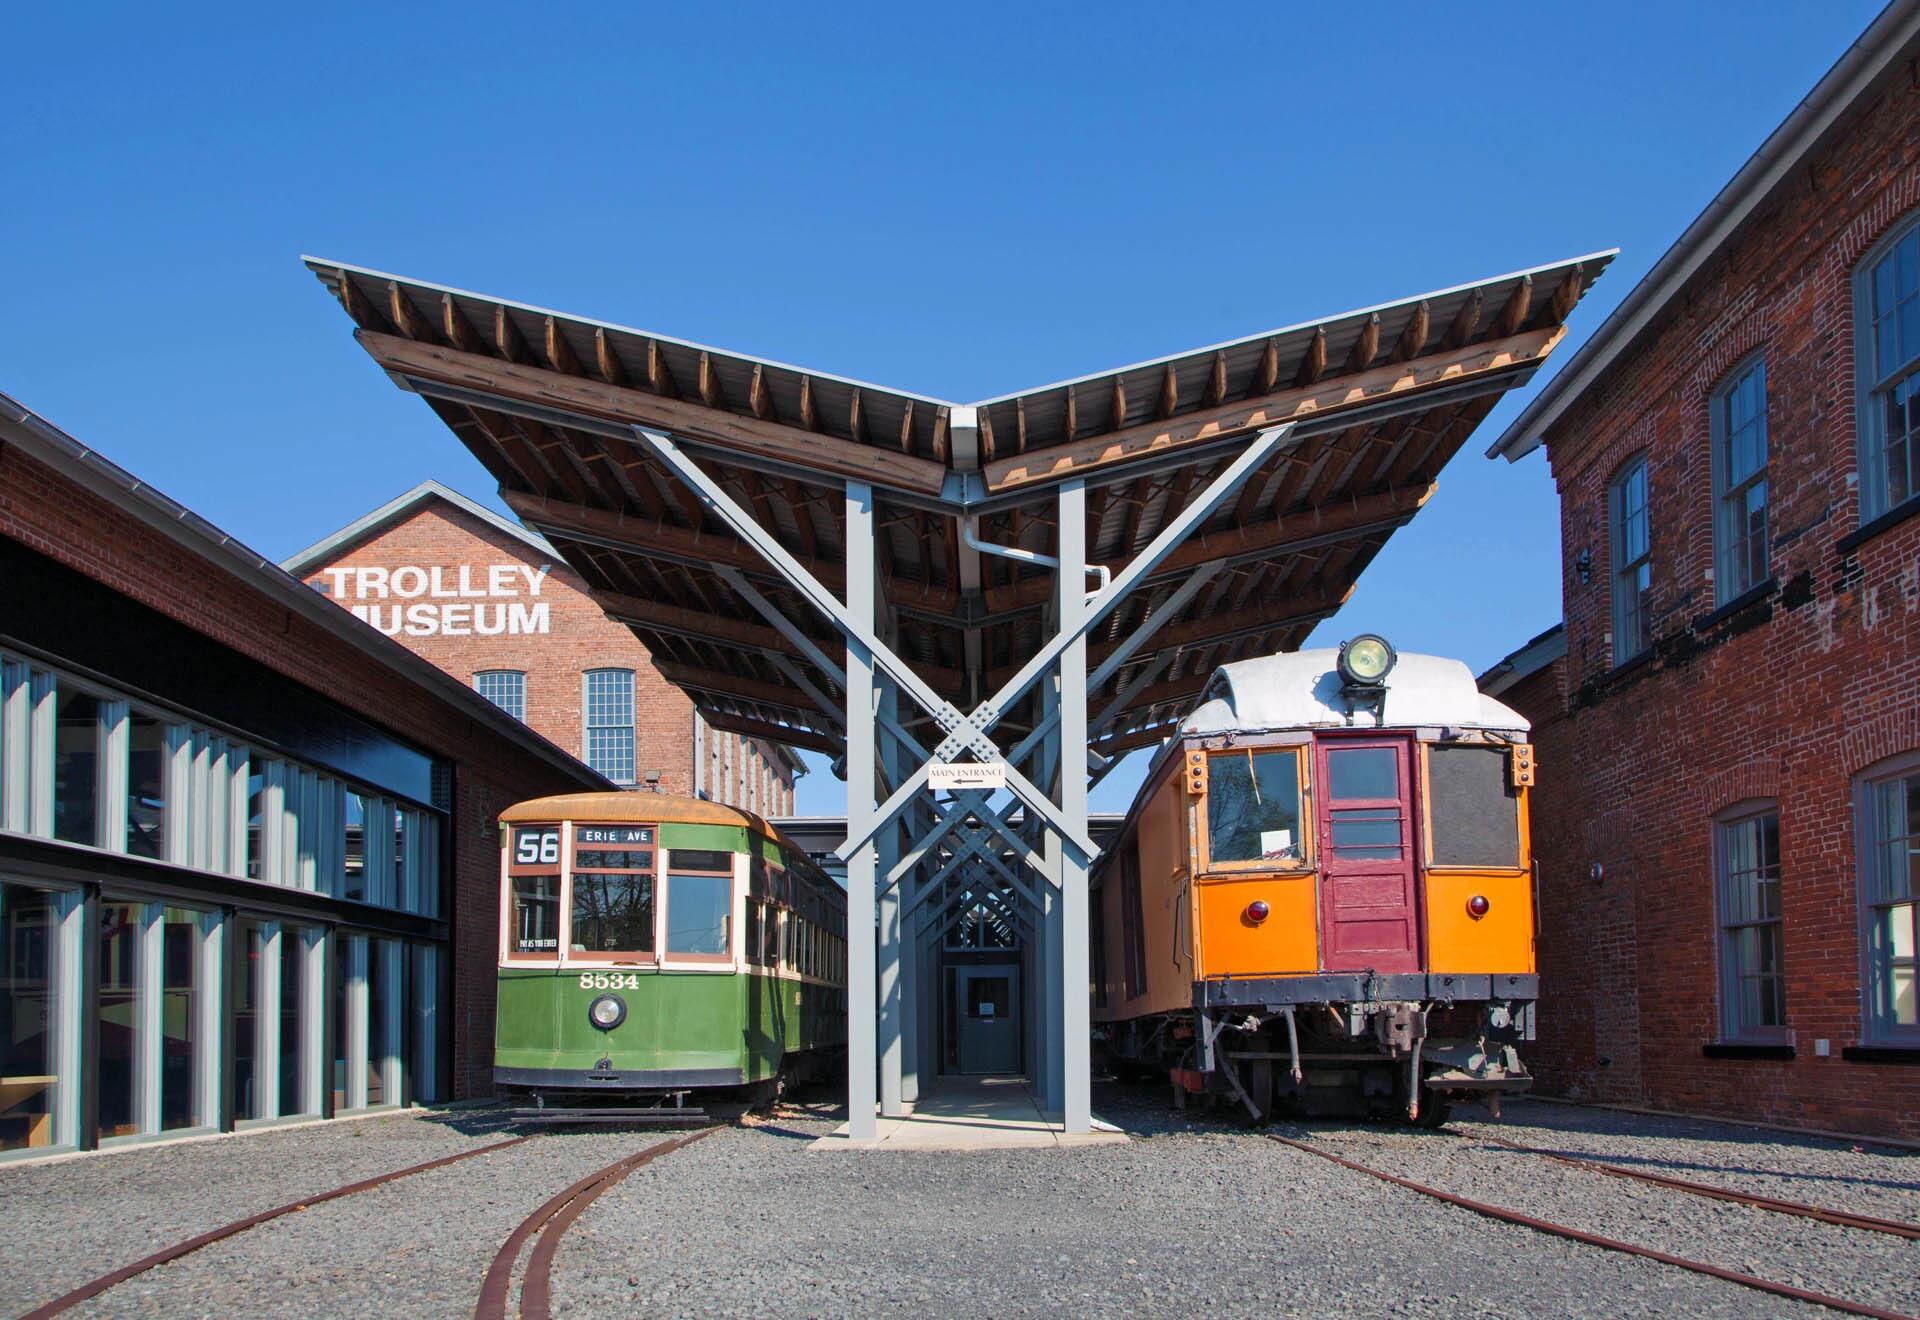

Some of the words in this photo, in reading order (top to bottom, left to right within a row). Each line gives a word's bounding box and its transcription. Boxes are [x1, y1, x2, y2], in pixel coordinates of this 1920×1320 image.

[323, 564, 551, 599] TROLLEY
[930, 768, 955, 777] MAIN
[957, 768, 1002, 777] ENTRANCE
[586, 831, 616, 841] ERIE
[627, 831, 647, 841] AVE
[517, 833, 559, 863] 56
[579, 972, 639, 990] 8534
